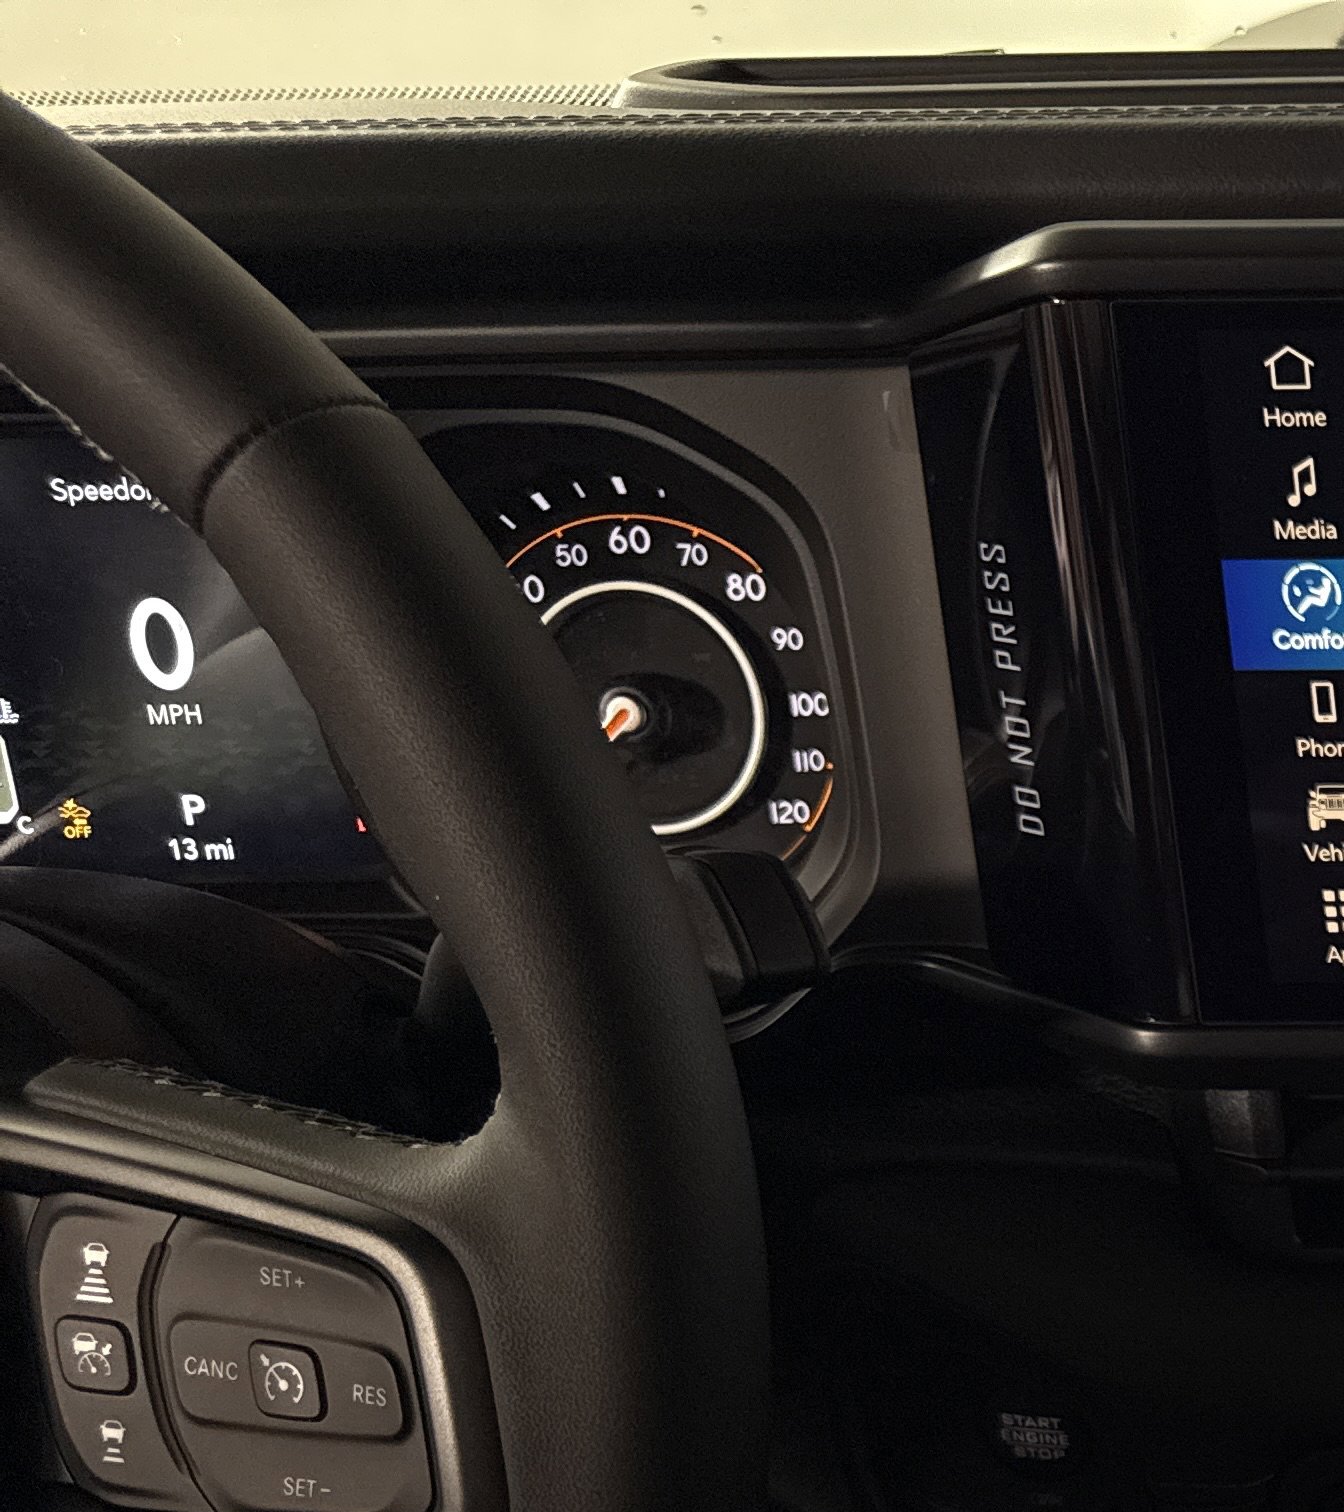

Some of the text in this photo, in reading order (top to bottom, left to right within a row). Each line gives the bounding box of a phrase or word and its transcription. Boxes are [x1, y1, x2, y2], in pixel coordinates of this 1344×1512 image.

[1263, 408, 1328, 428] Home
[50, 476, 152, 507] Speedo
[608, 524, 651, 555] 60
[1273, 519, 1338, 541] Media
[555, 543, 588, 567] 50
[676, 543, 708, 567] 70
[522, 574, 546, 603] 0
[725, 573, 767, 602] 80
[130, 597, 194, 691] 0
[771, 627, 804, 650] 90
[978, 540, 1046, 837] DO NOT PRESS
[146, 703, 203, 725] MPH
[789, 692, 829, 717] 100
[793, 749, 825, 772] 110
[181, 793, 206, 826] P
[769, 801, 810, 825] 120
[16, 815, 34, 835] C
[63, 825, 92, 839] OFF
[168, 838, 235, 861] 13 mi
[259, 1267, 306, 1289] SET+
[184, 1356, 239, 1382] CANC
[352, 1384, 387, 1407] RES
[1001, 1413, 1062, 1429] START
[1001, 1429, 1070, 1446] ENGINE
